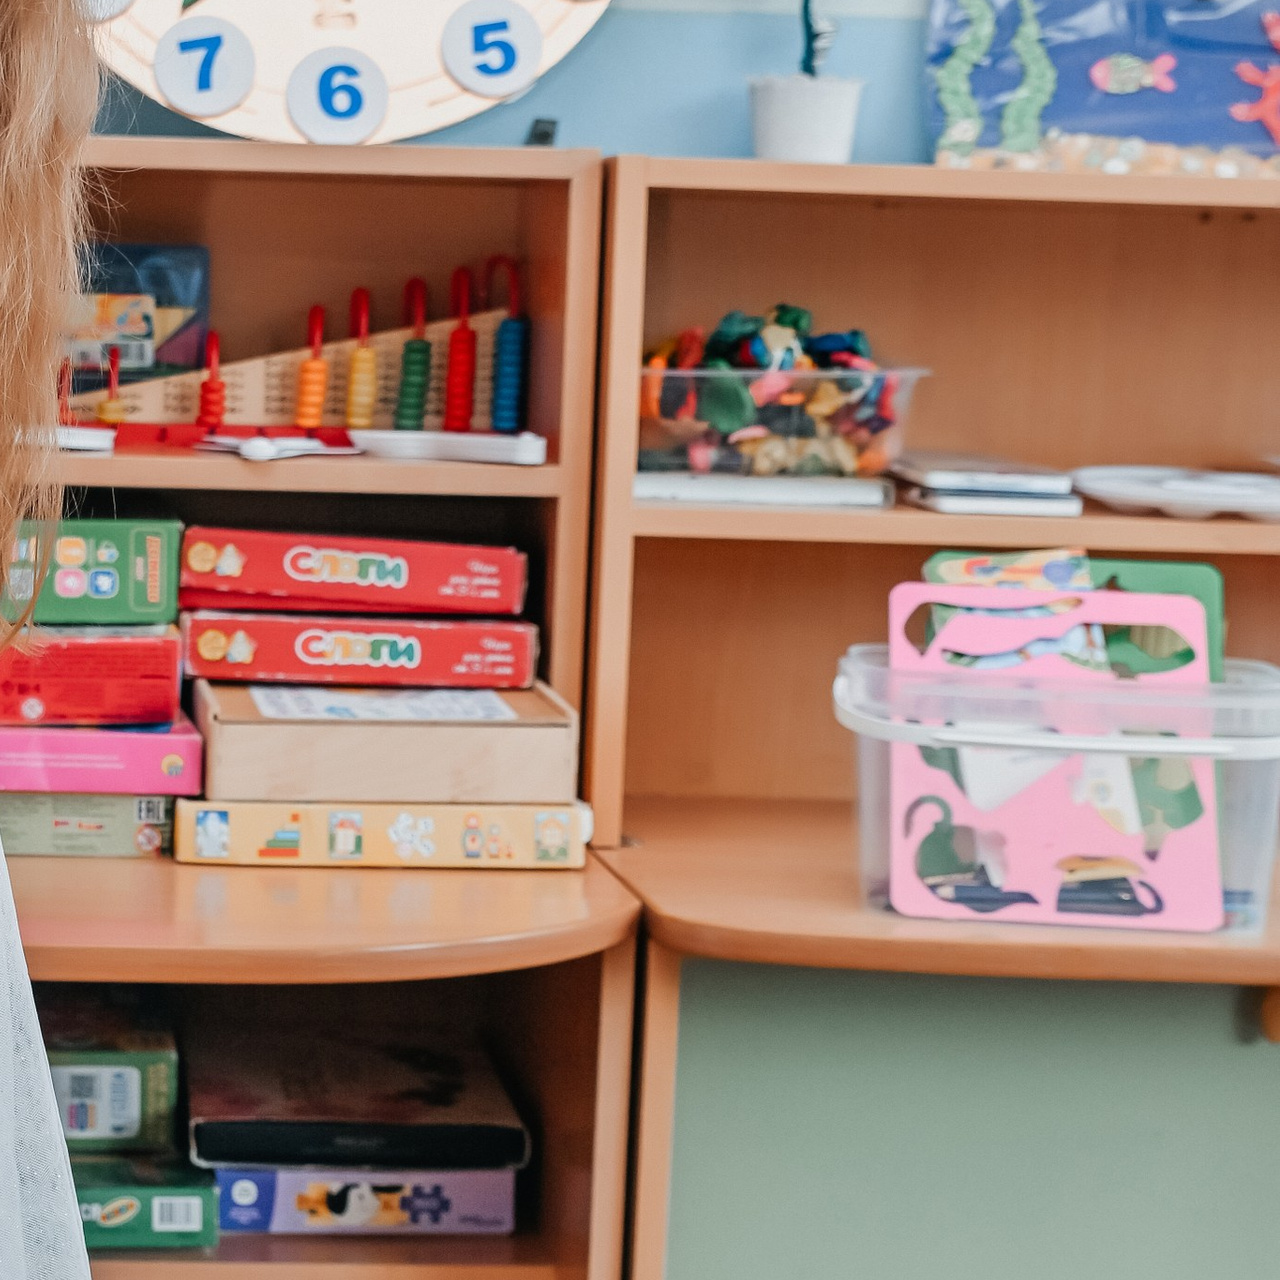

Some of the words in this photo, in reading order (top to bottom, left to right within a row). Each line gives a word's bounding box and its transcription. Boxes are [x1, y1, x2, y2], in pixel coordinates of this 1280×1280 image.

[176, 33, 225, 93] 7
[470, 18, 519, 78] 5
[316, 62, 366, 121] 6
